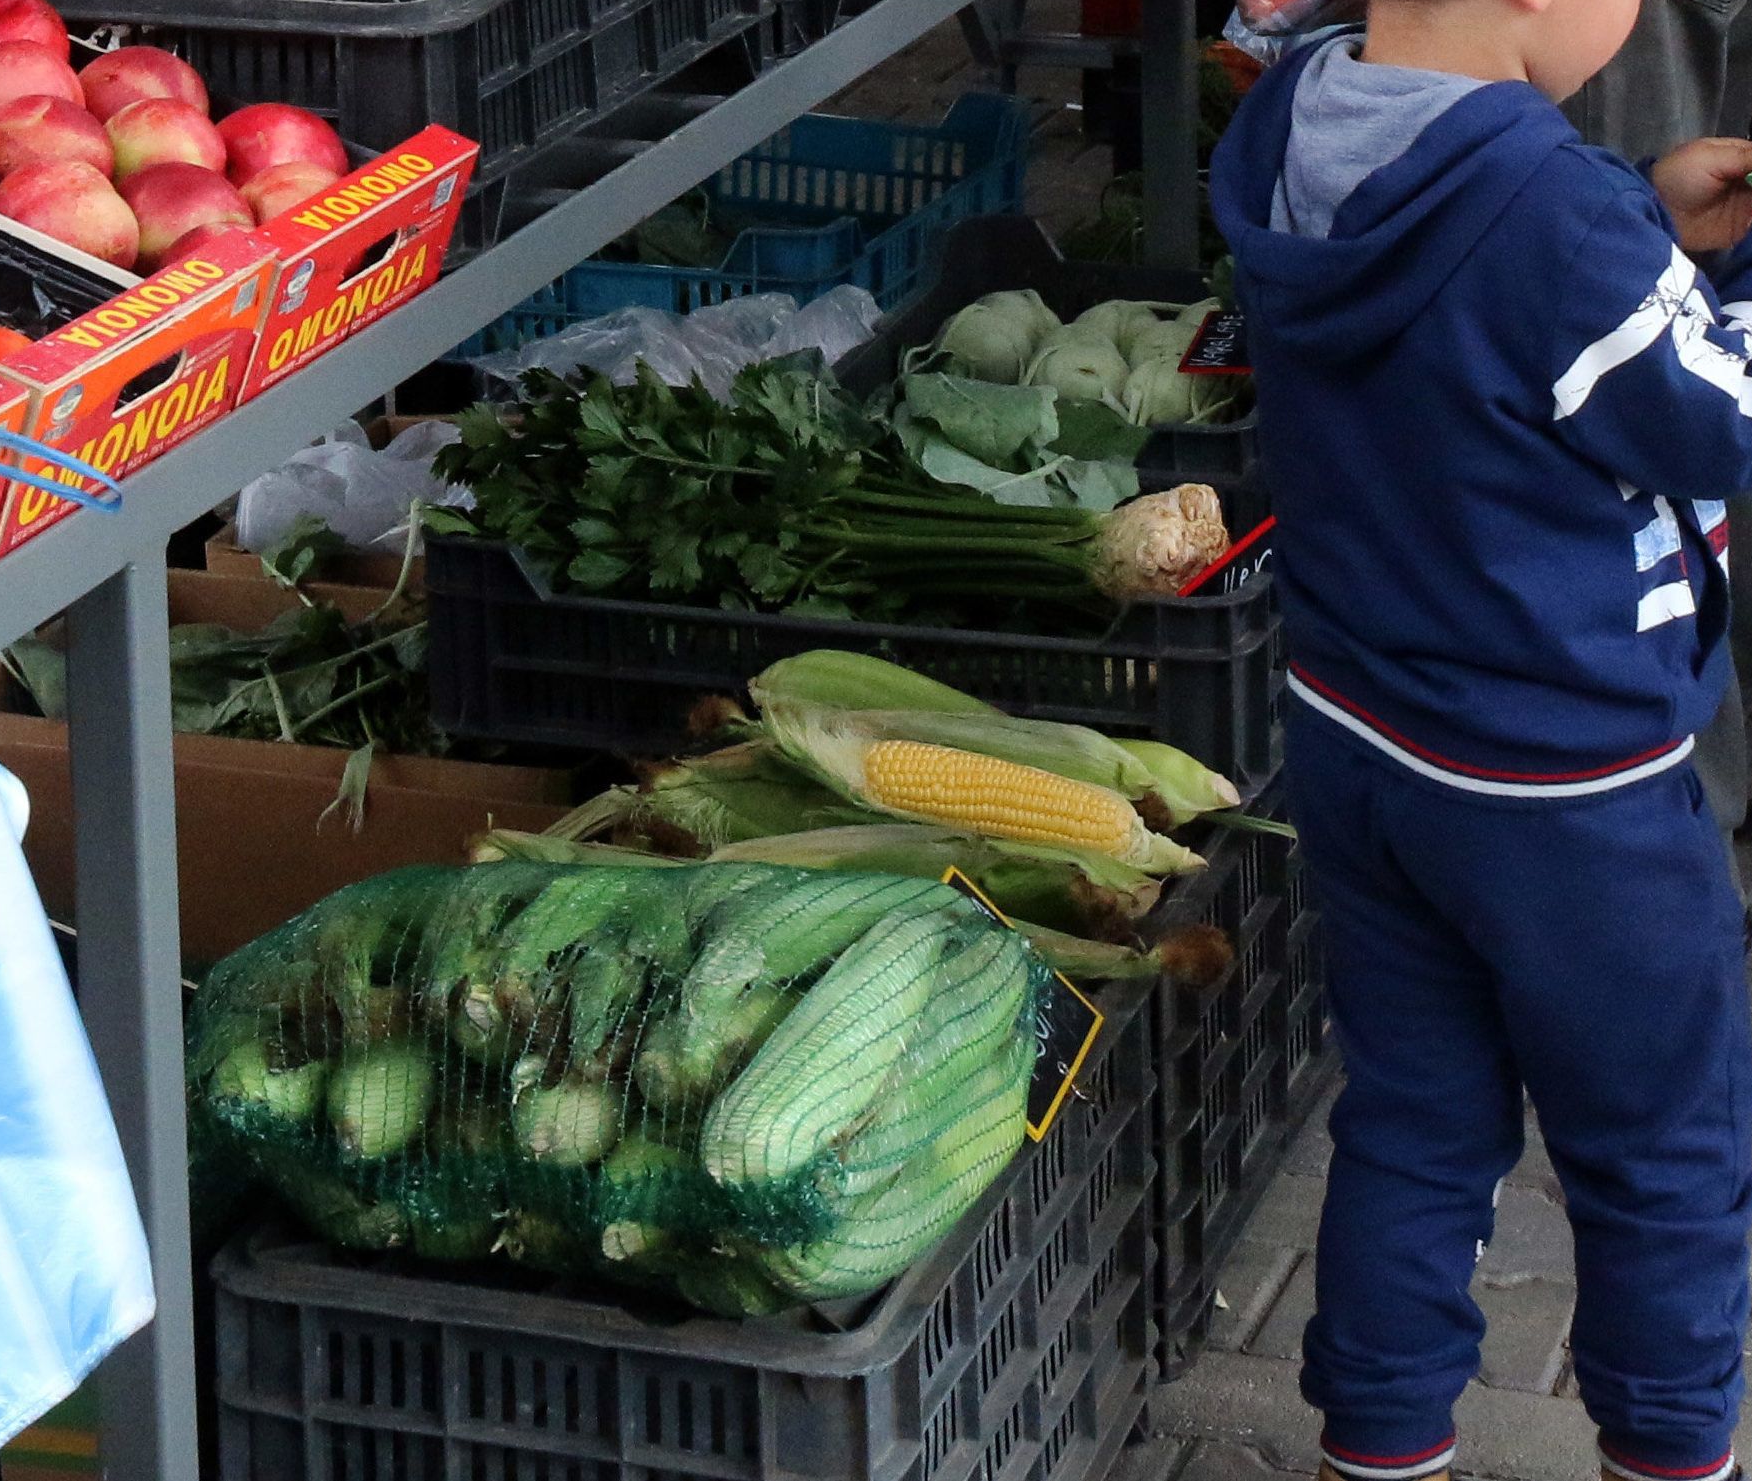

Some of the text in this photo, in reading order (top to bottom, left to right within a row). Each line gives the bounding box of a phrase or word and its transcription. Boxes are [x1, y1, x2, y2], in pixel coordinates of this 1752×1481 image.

[292, 153, 434, 231] OMONOIA
[58, 260, 224, 348] OMONOIA
[269, 244, 428, 371] OMONOIA
